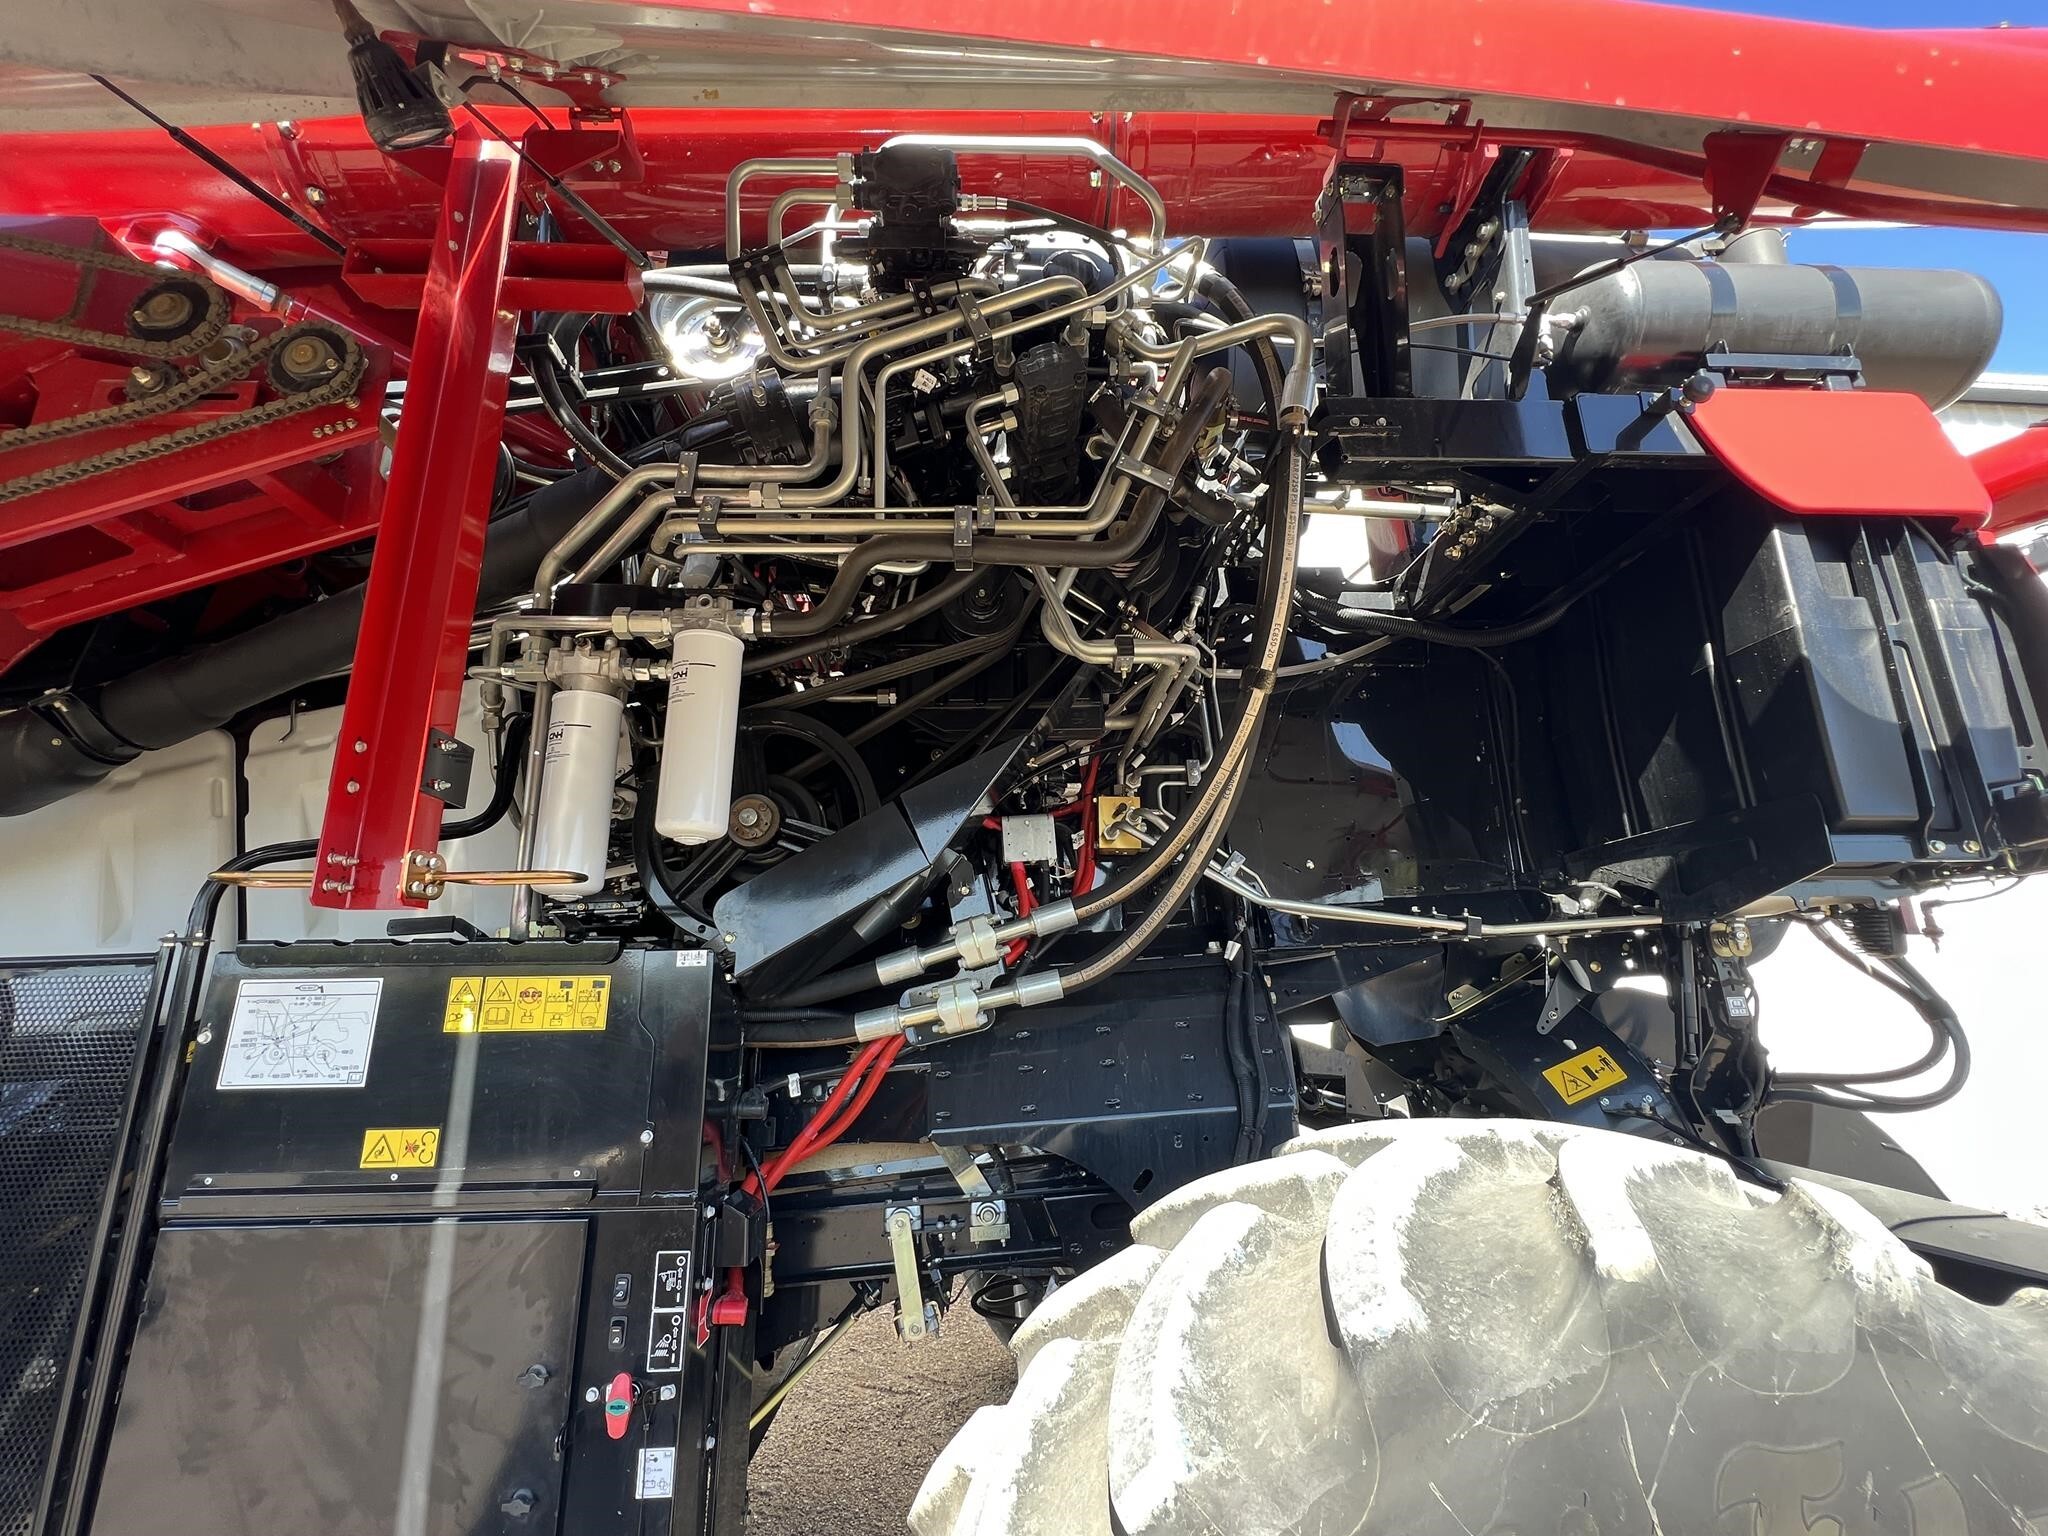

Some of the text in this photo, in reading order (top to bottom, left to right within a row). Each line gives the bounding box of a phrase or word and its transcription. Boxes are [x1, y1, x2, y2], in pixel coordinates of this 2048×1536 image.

[1267, 623, 1281, 658] EC850-20
[673, 668, 688, 680] CNH
[549, 728, 564, 740] CNH
